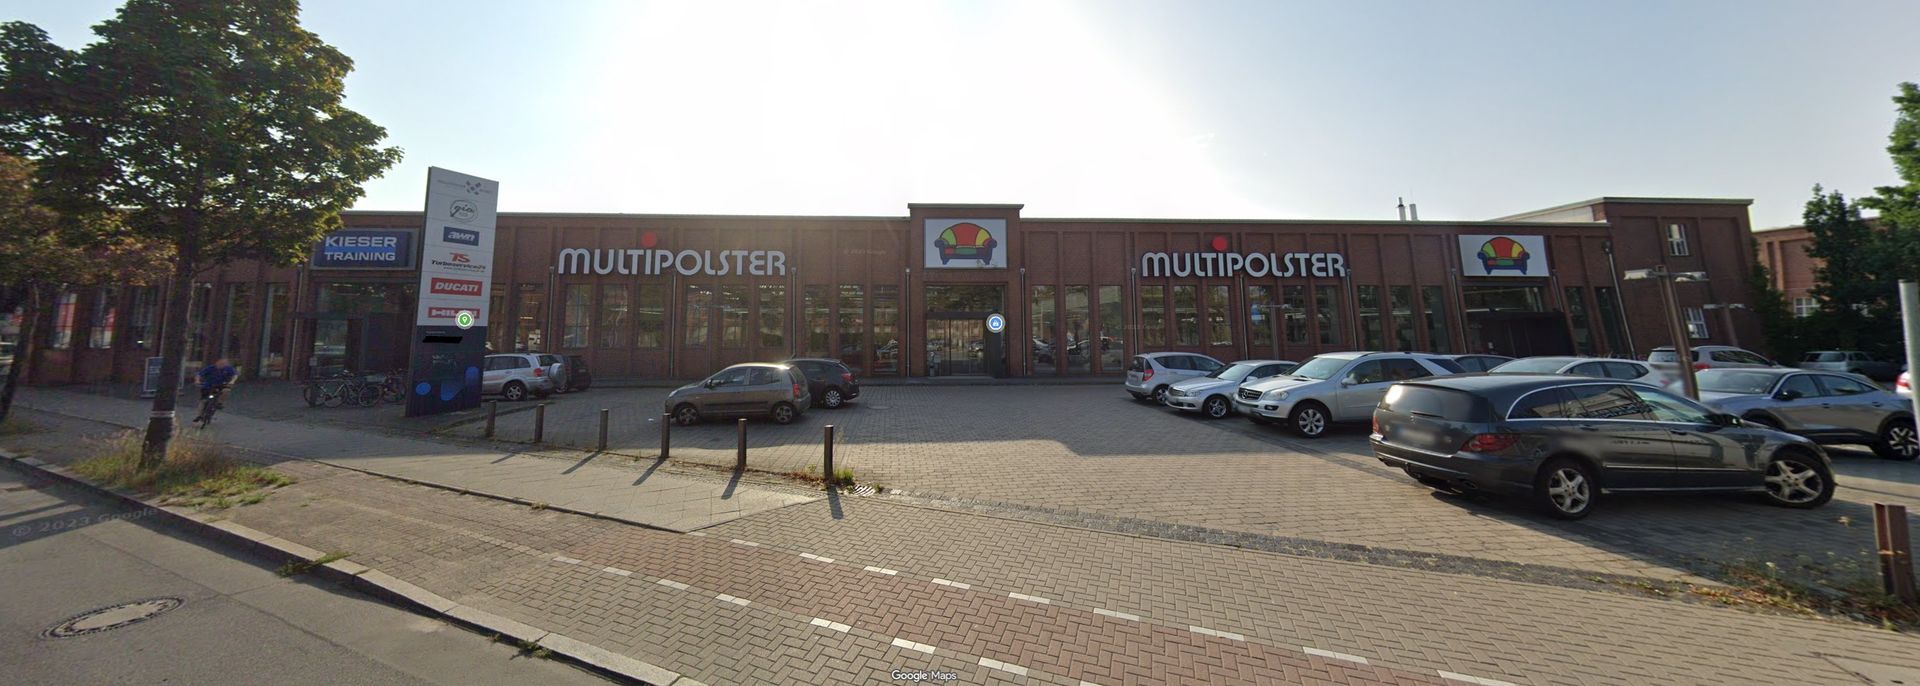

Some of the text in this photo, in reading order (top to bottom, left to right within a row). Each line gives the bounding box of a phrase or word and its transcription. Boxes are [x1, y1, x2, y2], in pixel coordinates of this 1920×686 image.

[325, 236, 397, 247] KIESER
[324, 252, 396, 261] TRAINING
[449, 252, 471, 263] TS
[557, 248, 786, 276] MULTIPOLSTER
[1142, 251, 1346, 278] MULTIPOLSTER
[434, 281, 479, 292] DUCATI
